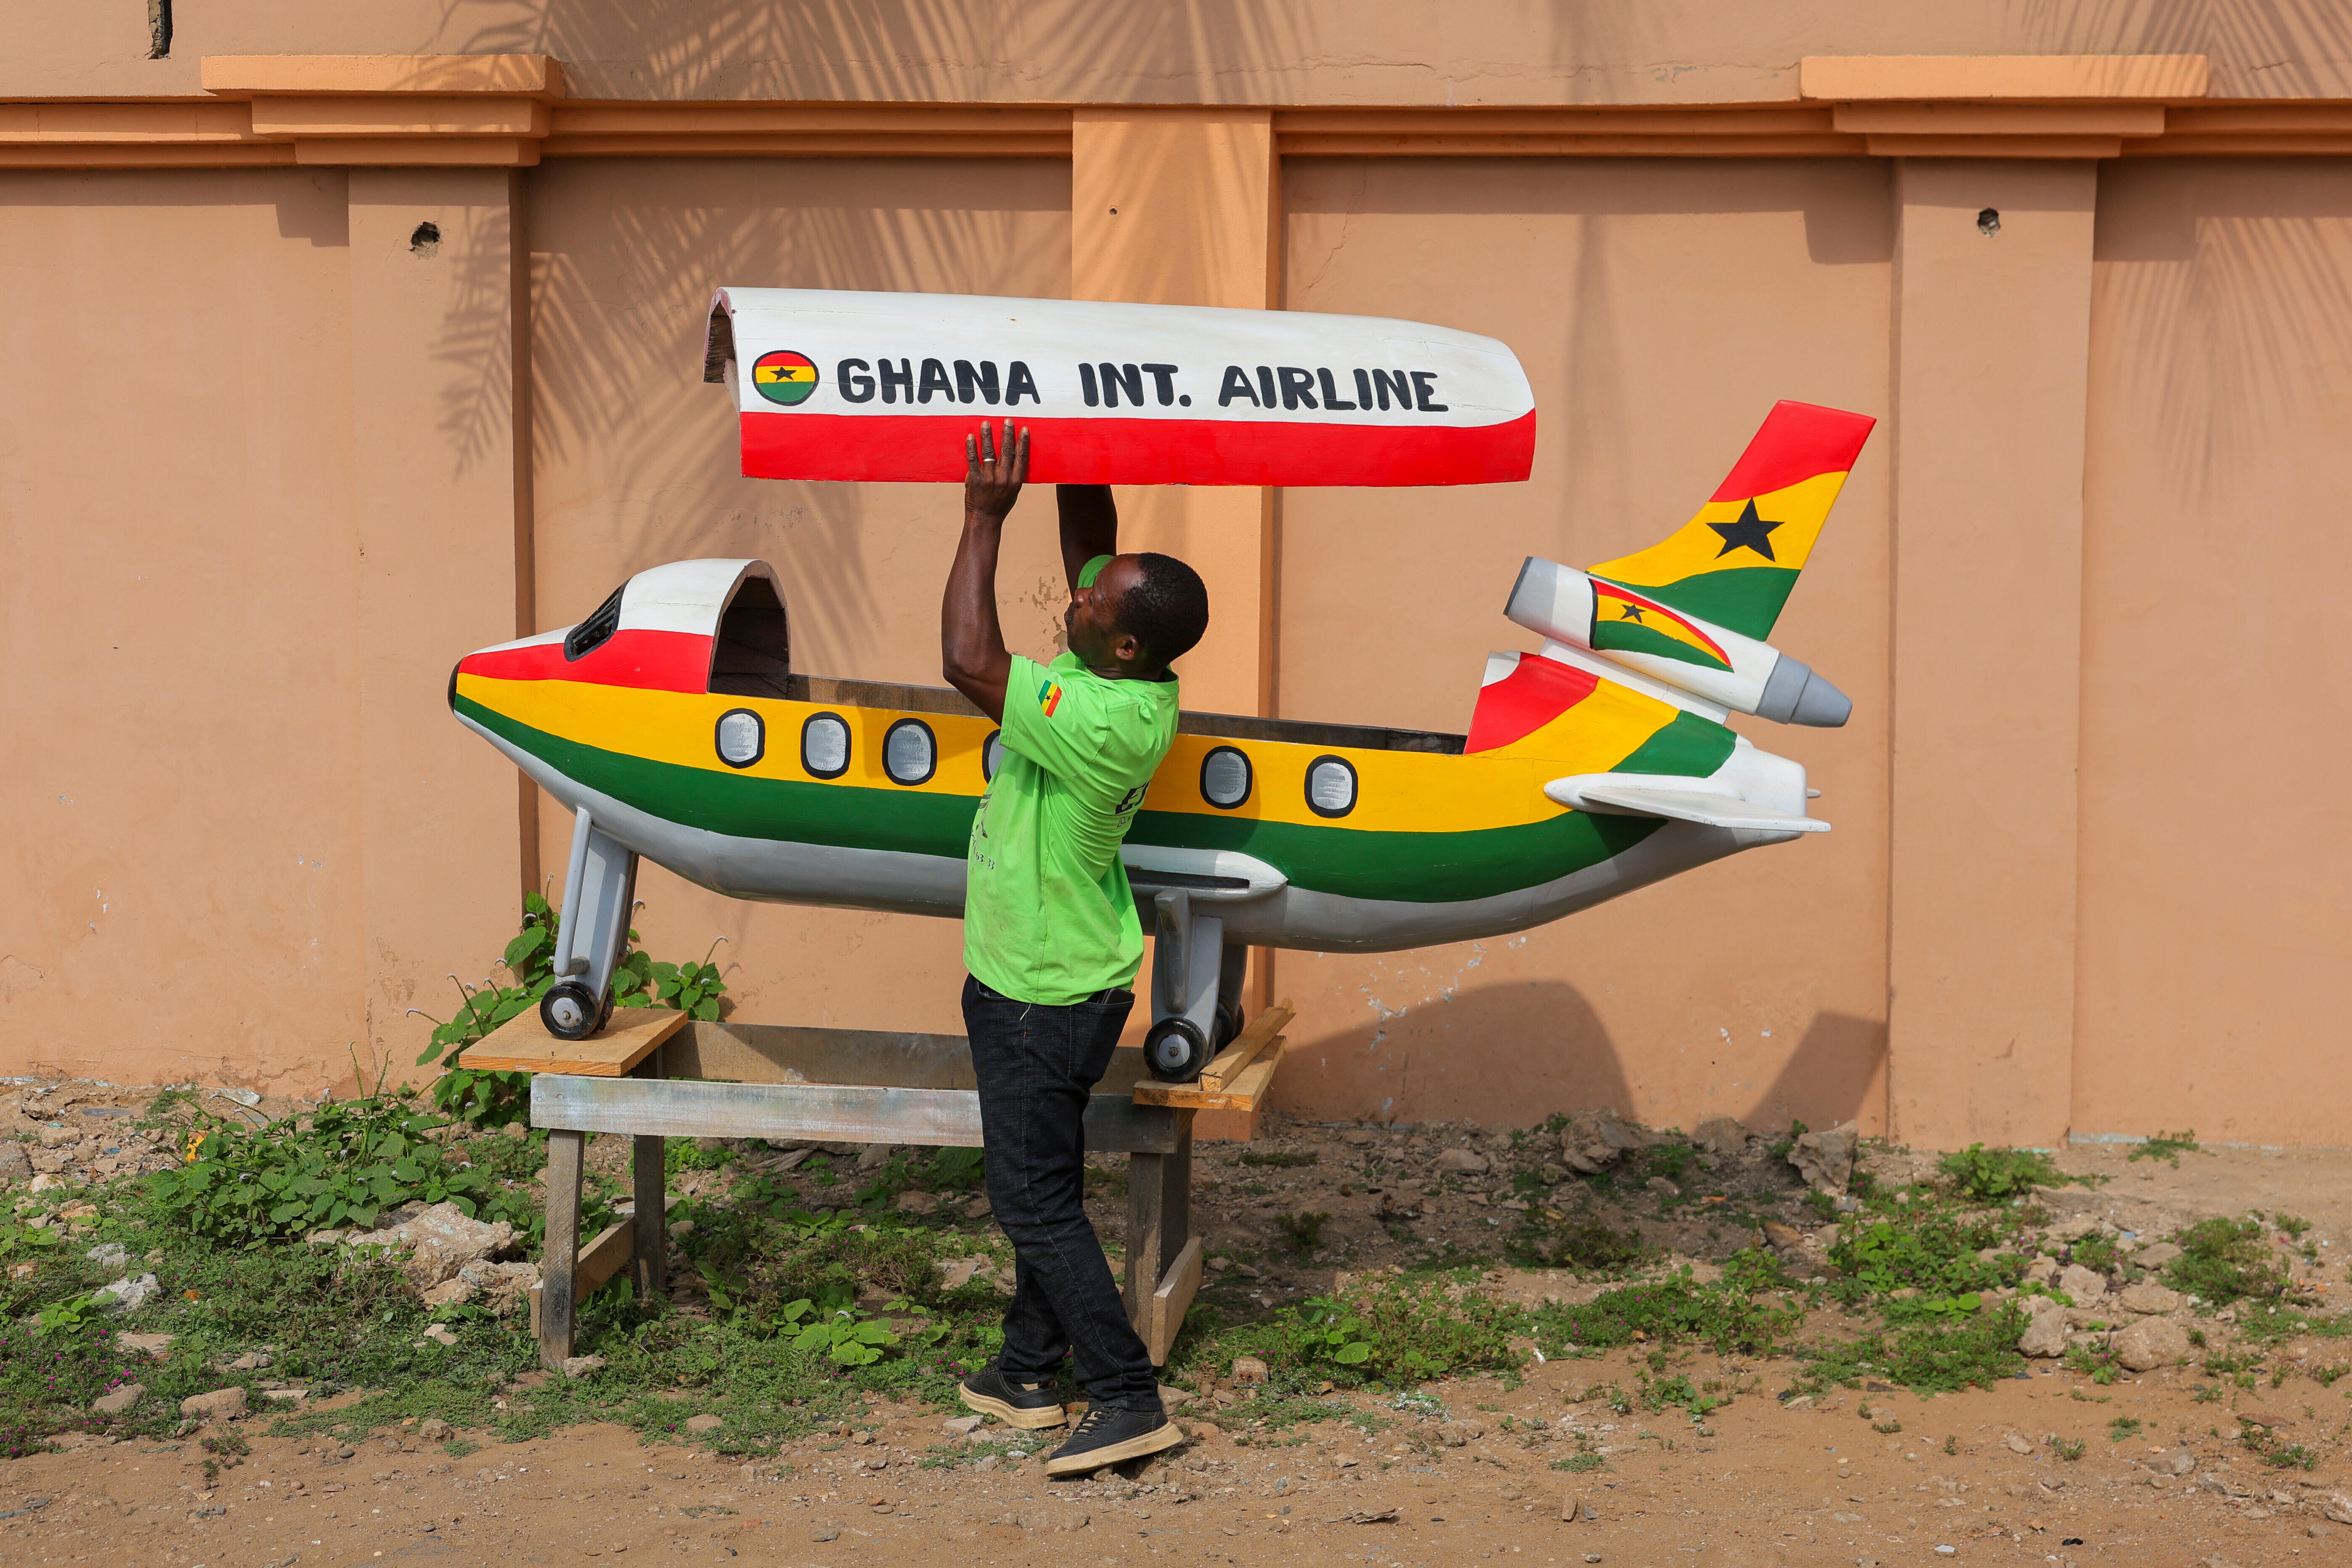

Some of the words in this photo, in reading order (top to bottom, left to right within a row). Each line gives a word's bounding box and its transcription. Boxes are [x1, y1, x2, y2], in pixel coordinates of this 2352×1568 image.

[837, 358, 1042, 406] GHANA
[1078, 362, 1192, 409] INT.
[1218, 365, 1449, 412] AIRLINE
[976, 852, 984, 862] 63
[987, 858, 995, 870] 33
